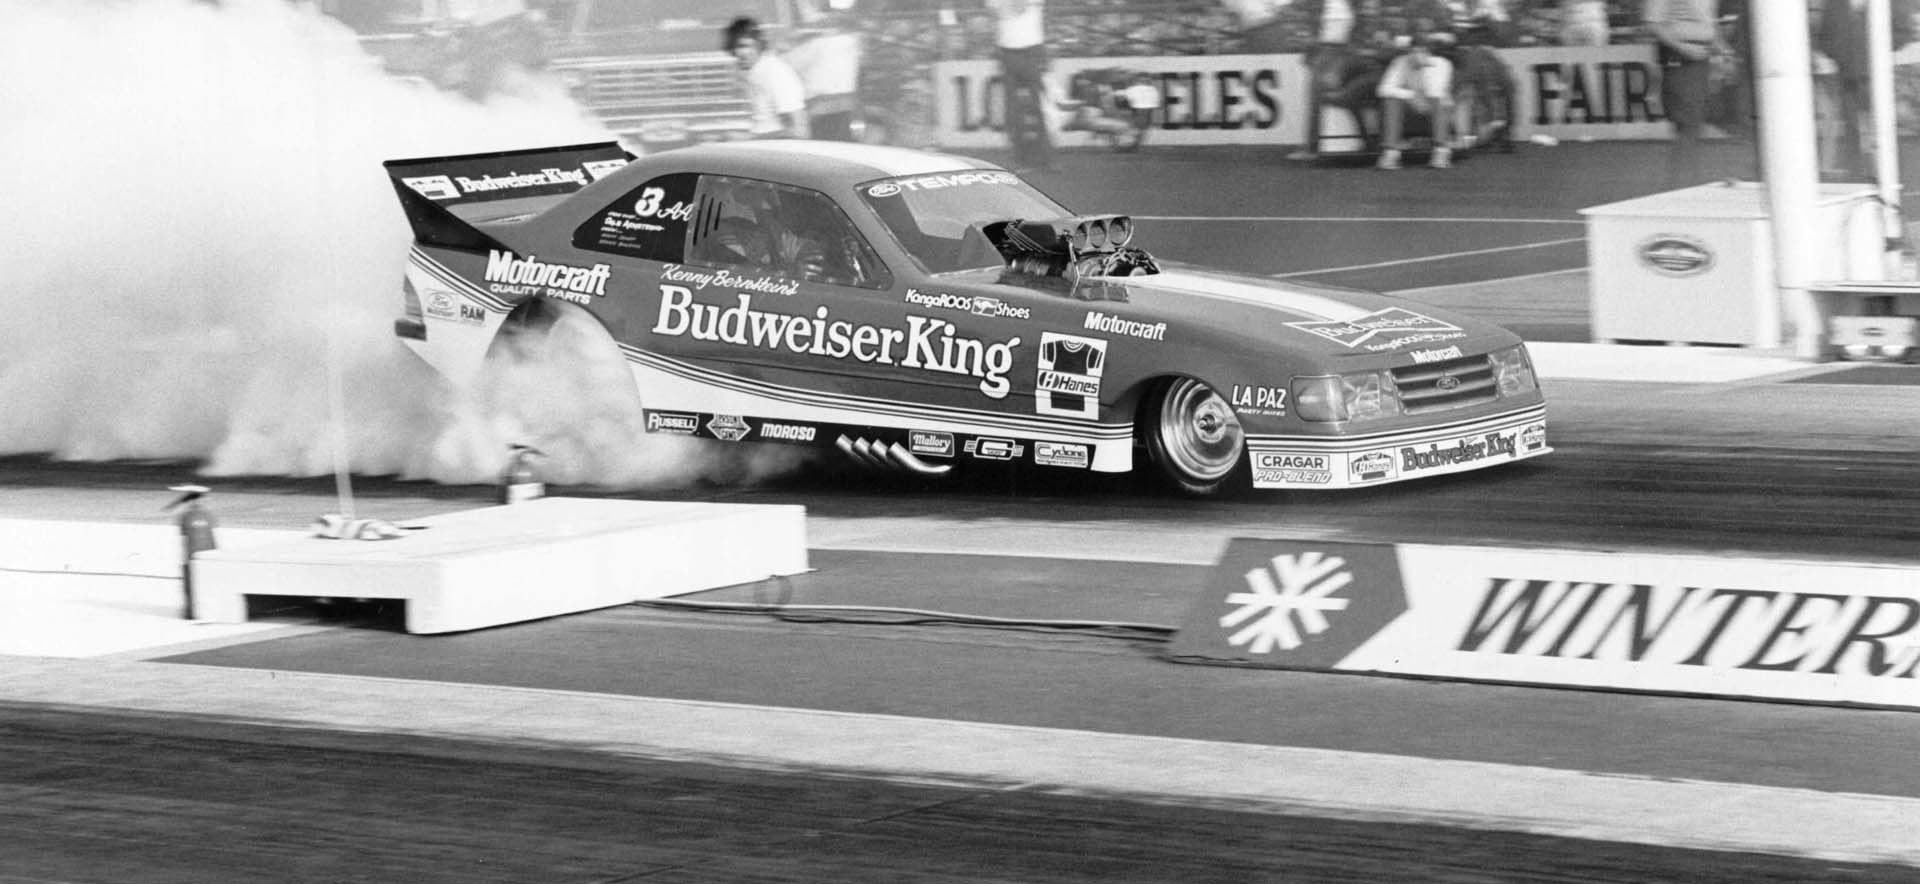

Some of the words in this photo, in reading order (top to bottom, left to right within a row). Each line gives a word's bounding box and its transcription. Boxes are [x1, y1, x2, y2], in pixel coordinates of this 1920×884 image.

[1154, 68, 1282, 131] ELES
[1534, 61, 1669, 125] FAIR
[454, 170, 545, 193] Budweiser
[635, 187, 665, 216] 3
[485, 250, 611, 296] Motorcraft
[661, 263, 713, 290] Kenny
[712, 270, 800, 296] Bernstein's
[490, 283, 540, 296] QUALITY
[547, 288, 592, 304] PARTS
[905, 289, 972, 311] KangaROOS
[995, 303, 1030, 319] Shoes
[460, 304, 486, 322] RAM
[1084, 311, 1167, 341] Motorcraft
[652, 285, 904, 367] Budweiser
[901, 315, 1021, 399] King
[1058, 377, 1099, 394] Hanes
[1231, 385, 1252, 406] LA
[1256, 387, 1287, 409] PAZ
[649, 413, 697, 430] RUSSELL
[760, 423, 816, 441] MOROSO
[912, 434, 950, 448] Mallory
[1400, 439, 1487, 472] Budweiser
[1485, 432, 1517, 457] King
[1262, 455, 1324, 469] CRAGAR
[1255, 470, 1333, 483] PRO-BLEND
[1455, 578, 1920, 680] WINTER
